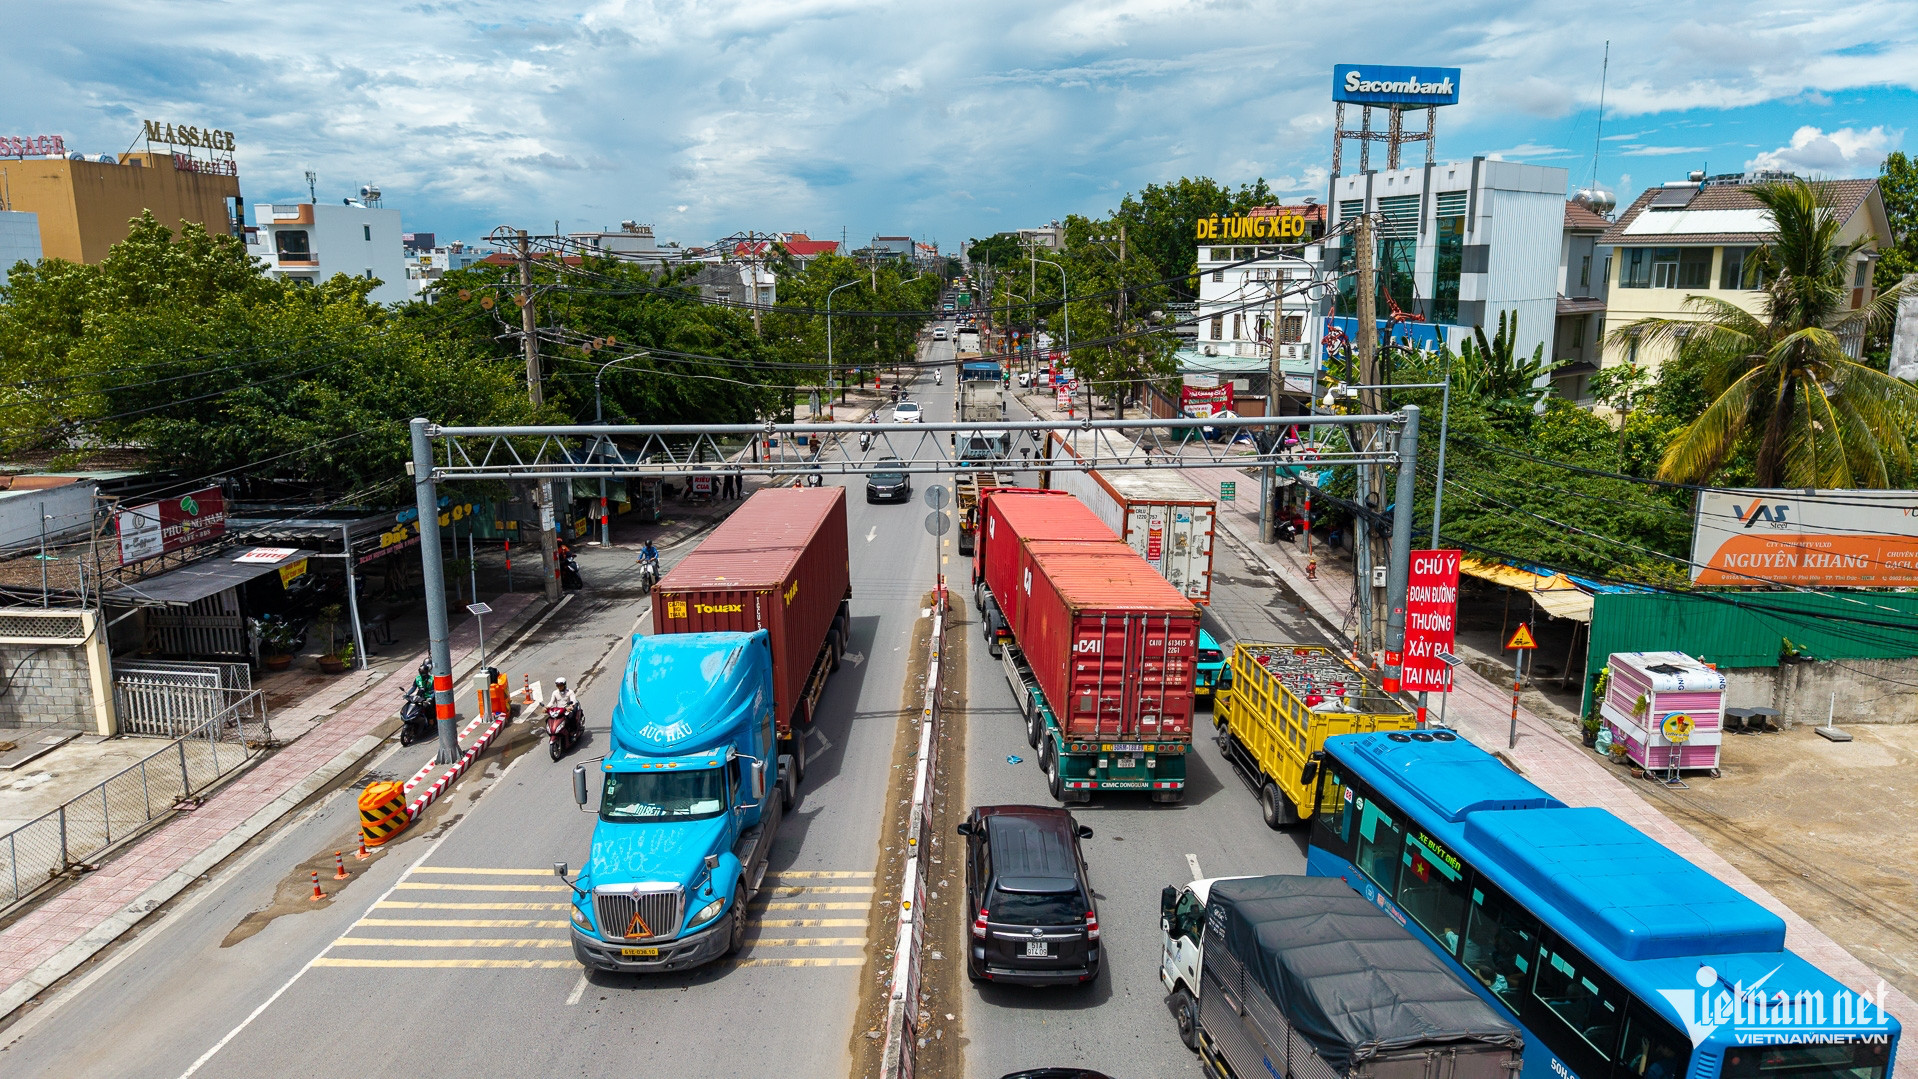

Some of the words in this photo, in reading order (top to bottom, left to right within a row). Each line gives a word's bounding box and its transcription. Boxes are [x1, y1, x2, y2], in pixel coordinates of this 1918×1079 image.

[1344, 71, 1454, 95] Sacombank
[144, 119, 236, 151] MASSAGE
[1197, 212, 1218, 239] DÊ
[1221, 211, 1265, 239] TÙNG
[1267, 209, 1305, 237] XẺO
[1732, 499, 1790, 528] VAS
[1414, 554, 1443, 575] CHÚ
[1446, 553, 1456, 575] Ý
[1723, 550, 1800, 568] NGUYÊN
[1802, 553, 1869, 569] KHANG
[1409, 586, 1431, 606] ĐOẠN
[1431, 582, 1457, 603] ĐƯỜNG
[1411, 610, 1451, 631] THƯỜNG
[1078, 639, 1101, 653] CAI
[1408, 636, 1432, 657] XẢY
[1404, 667, 1423, 684] TAI
[1418, 831, 1429, 845] XE
